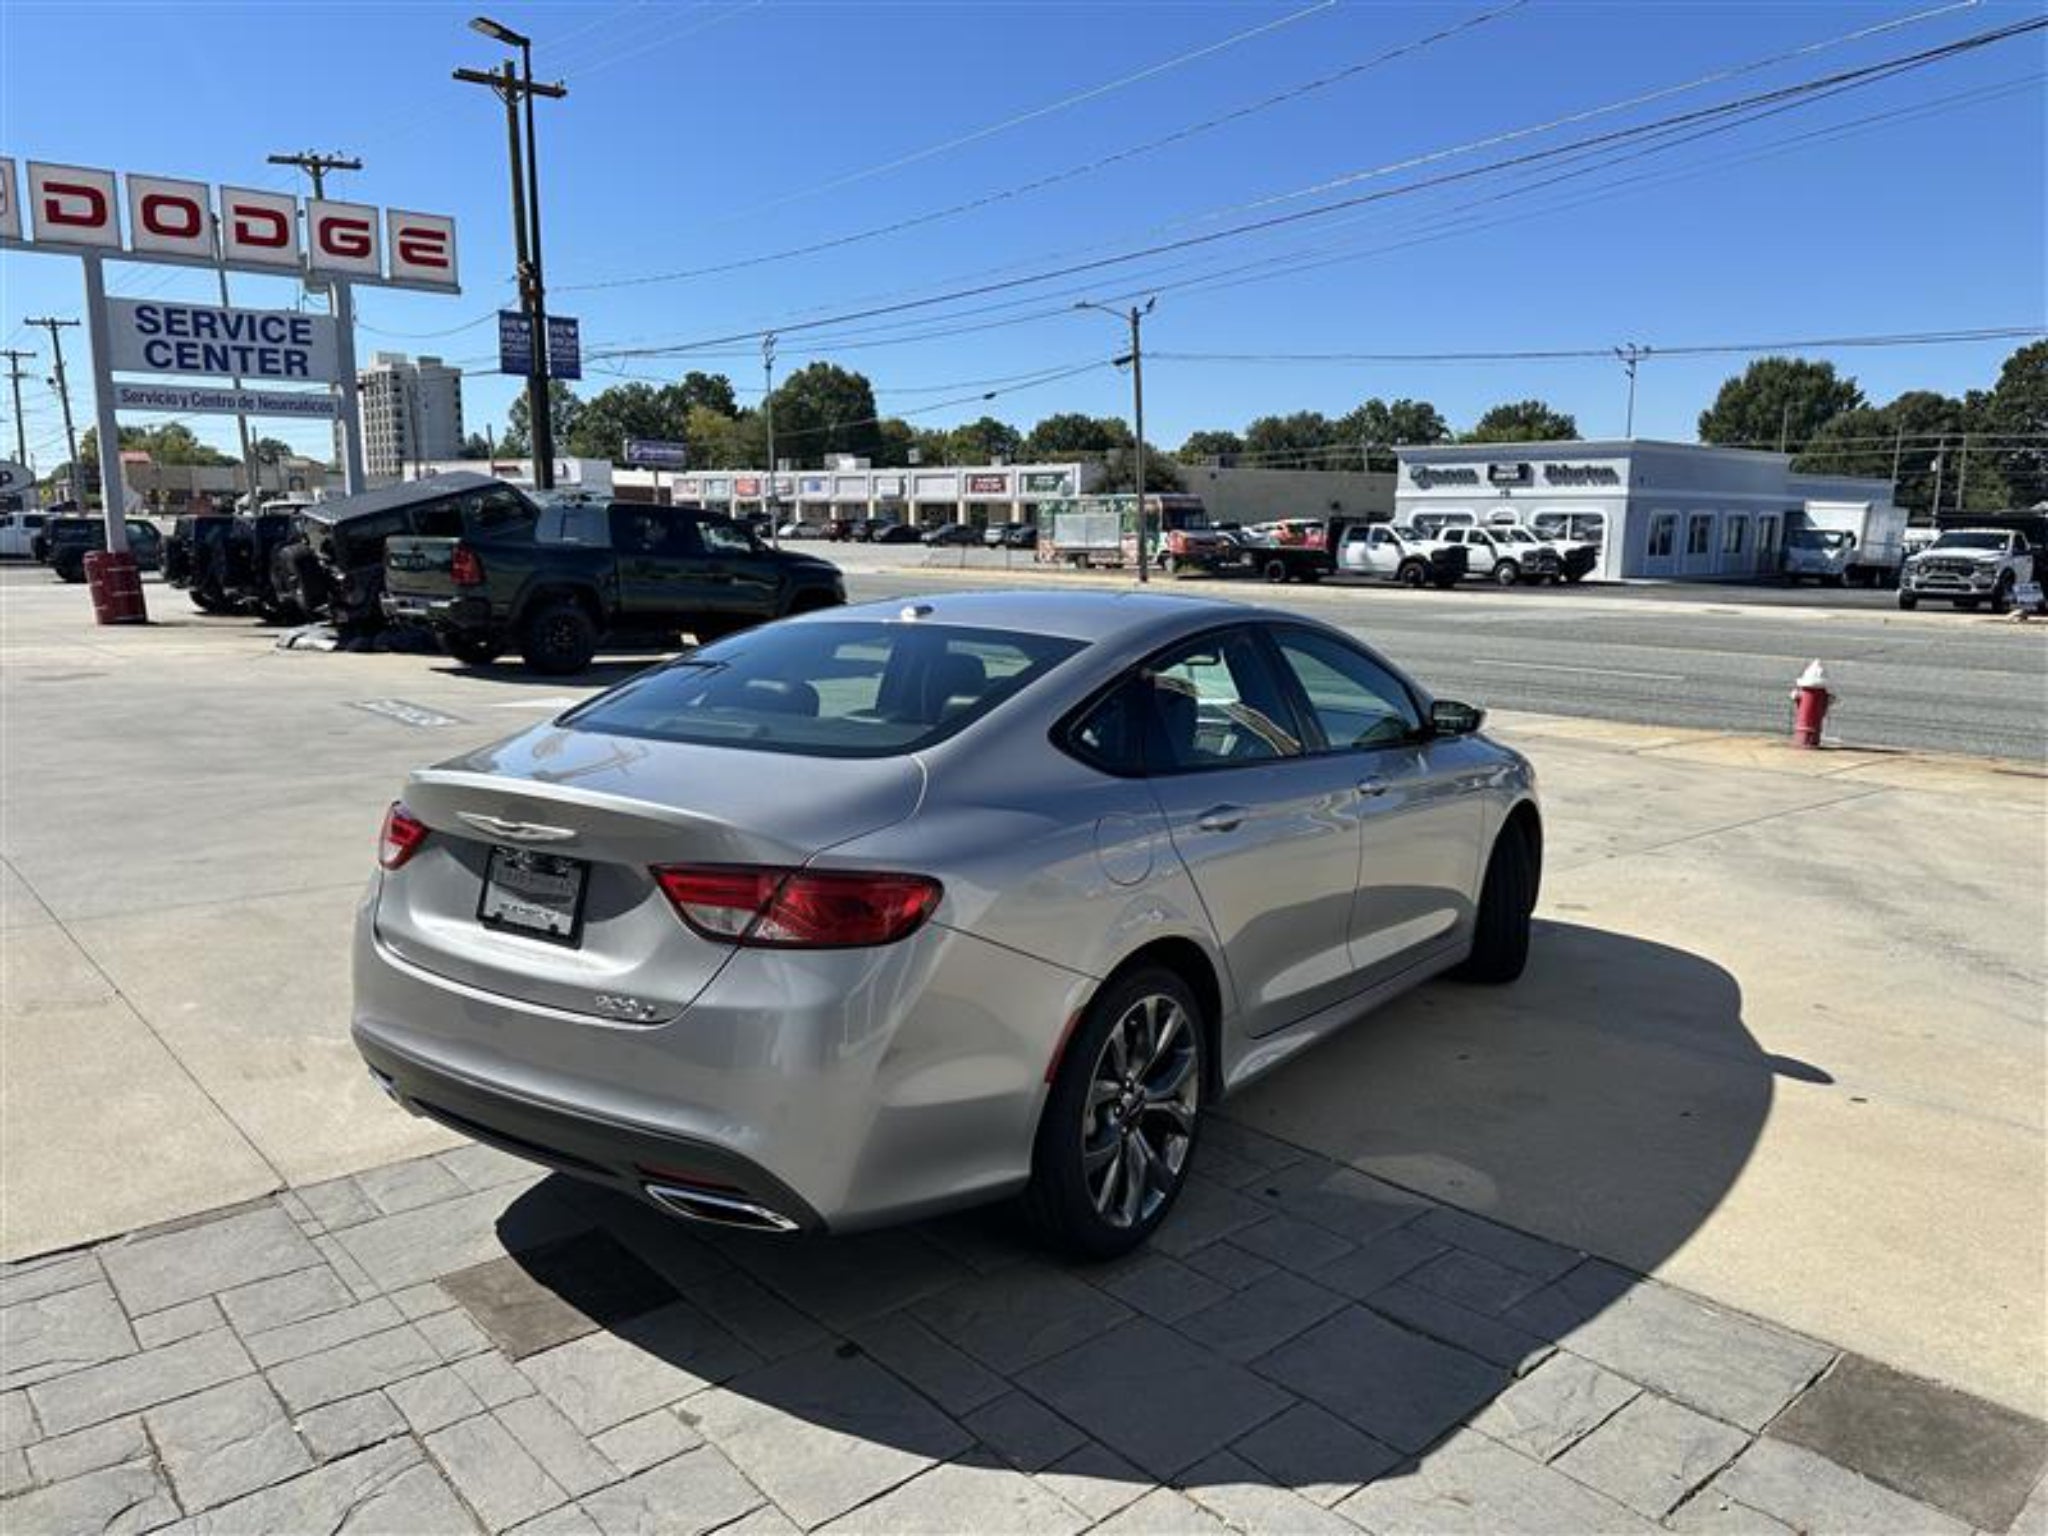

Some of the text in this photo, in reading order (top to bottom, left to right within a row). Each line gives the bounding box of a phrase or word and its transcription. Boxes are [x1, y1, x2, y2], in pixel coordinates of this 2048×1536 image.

[42, 180, 449, 268] DODGE
[135, 304, 313, 347] SERVICE
[144, 339, 309, 377] CENTER
[121, 388, 178, 406] Servicio
[191, 391, 236, 408] Centro
[238, 394, 255, 410] de
